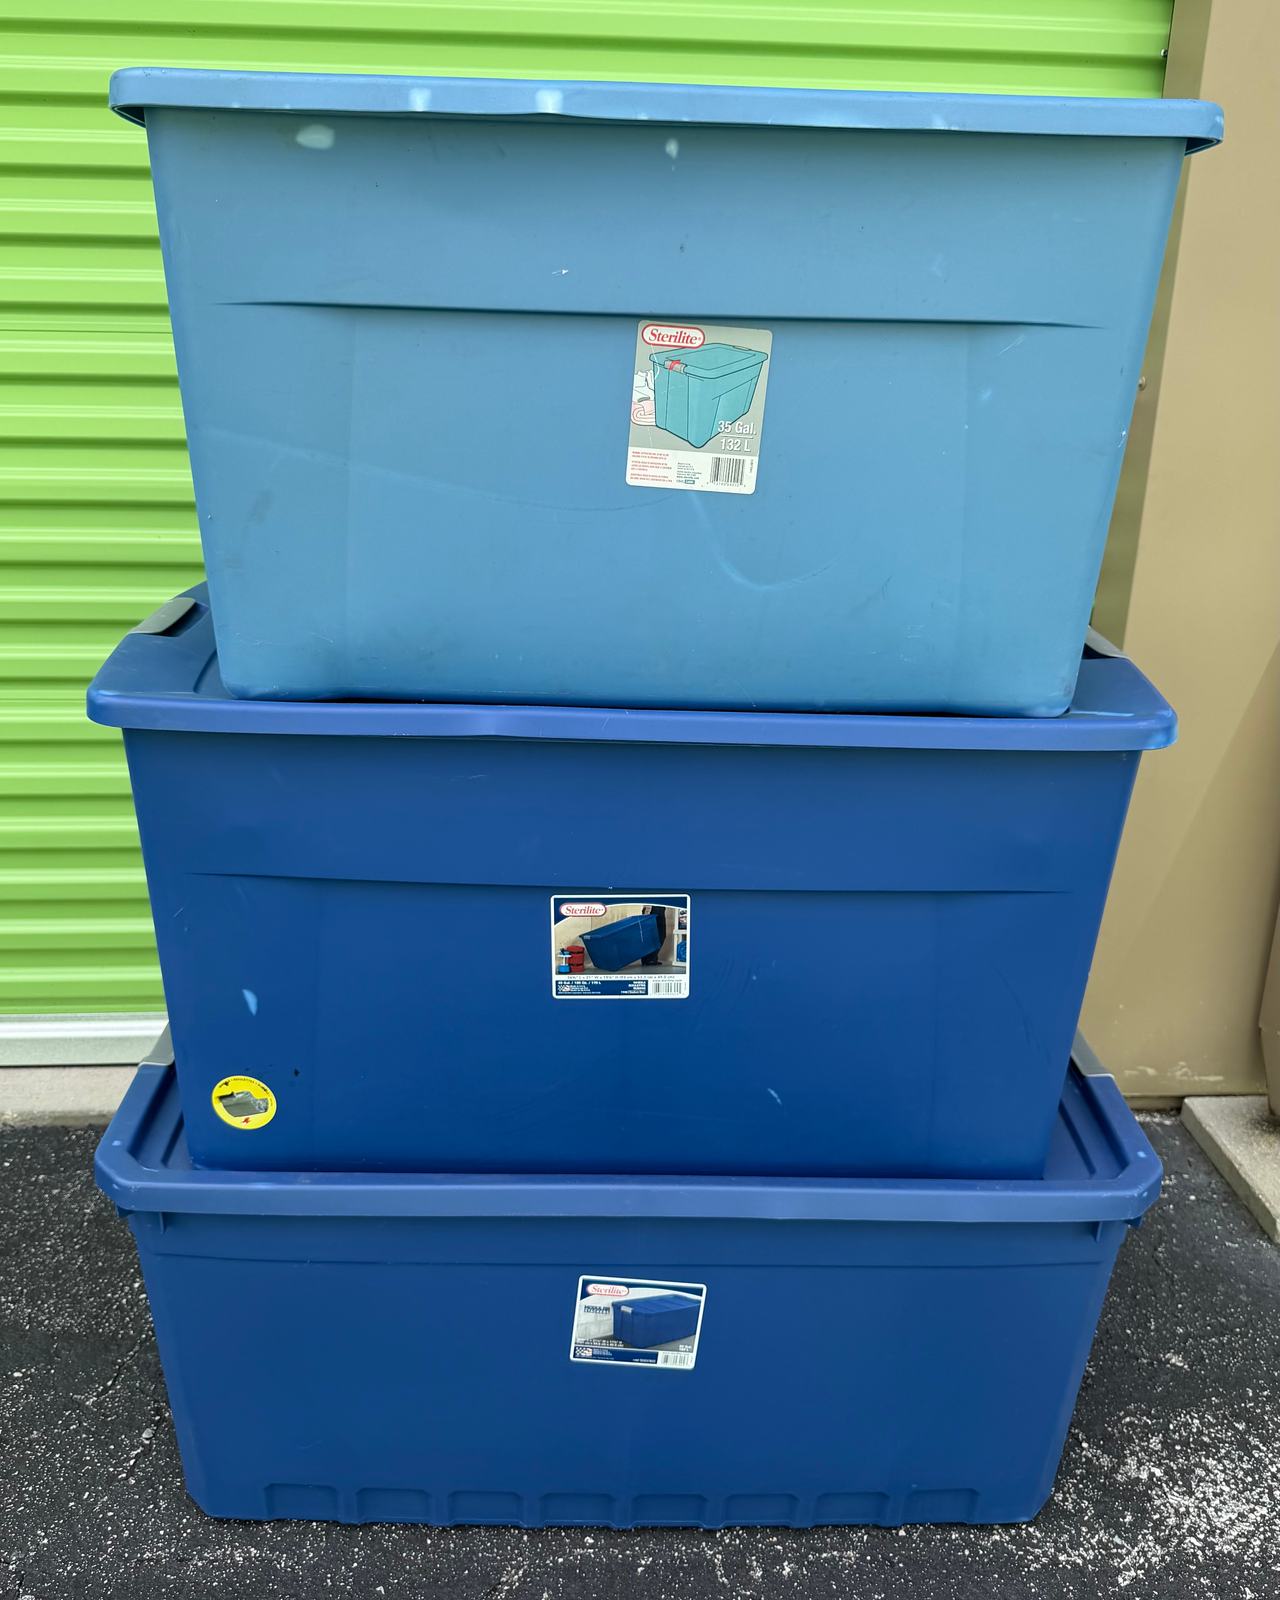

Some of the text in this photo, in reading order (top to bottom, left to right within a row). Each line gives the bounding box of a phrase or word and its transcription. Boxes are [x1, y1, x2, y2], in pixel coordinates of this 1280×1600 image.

[648, 328, 698, 345] Sterilite
[717, 420, 757, 435] 35 Gal.
[720, 438, 751, 452] 132 L
